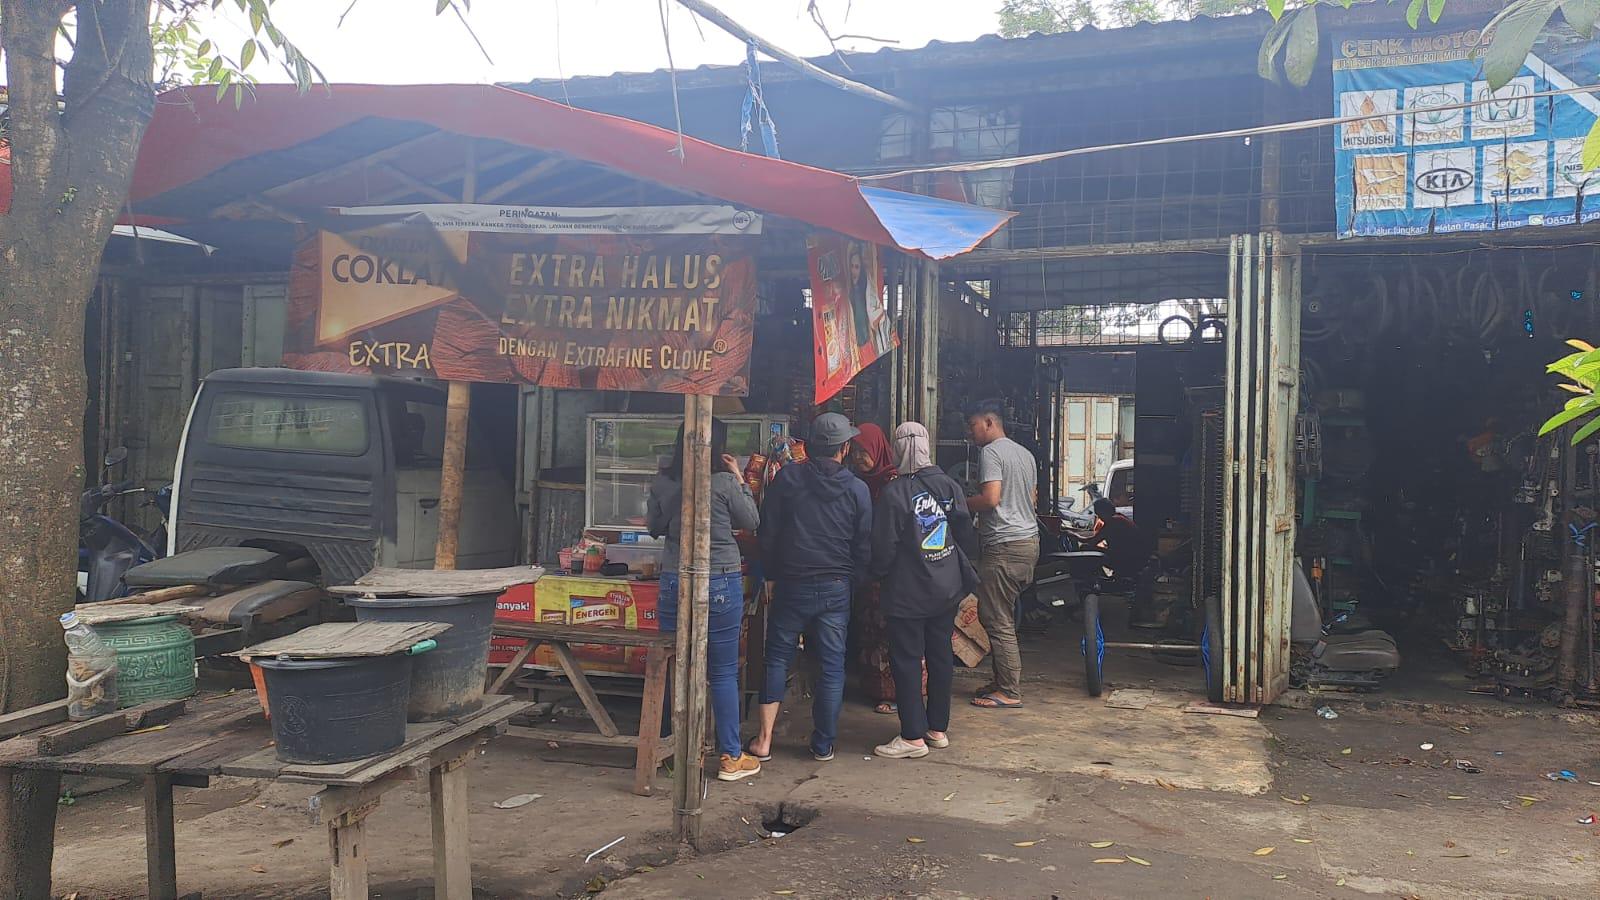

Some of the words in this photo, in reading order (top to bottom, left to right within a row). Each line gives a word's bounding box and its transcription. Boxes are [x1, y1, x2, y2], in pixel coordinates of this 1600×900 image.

[1341, 37, 1406, 58] CENK
[1343, 135, 1394, 147] MITSUBISHI
[1426, 173, 1465, 189] KIA
[1490, 186, 1540, 198] SUZUKI
[509, 252, 605, 288] EXTRA
[621, 254, 722, 289] HALUS
[501, 293, 593, 329] EXTRA
[605, 296, 720, 332] NIKMAT
[349, 340, 431, 370] EXTRA
[499, 337, 558, 359] DENGAN
[496, 601, 530, 612] anyak!
[575, 608, 617, 620] ENERGEN
